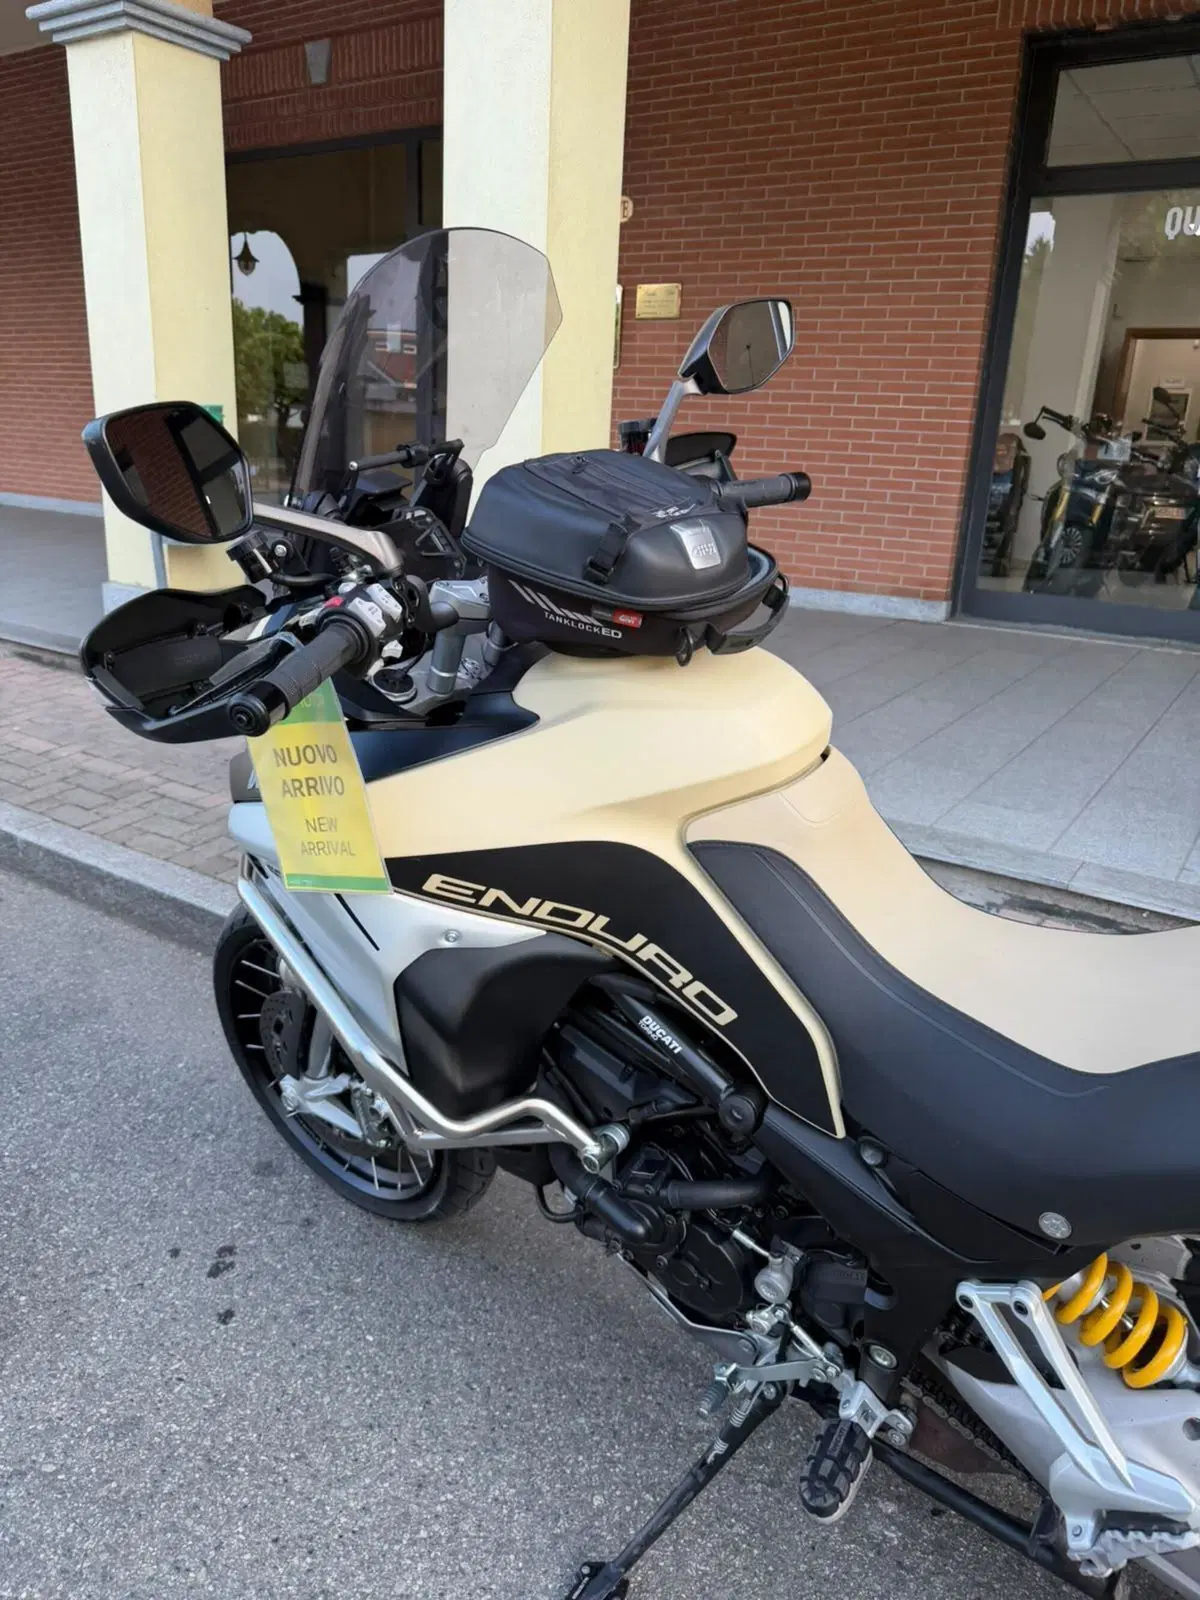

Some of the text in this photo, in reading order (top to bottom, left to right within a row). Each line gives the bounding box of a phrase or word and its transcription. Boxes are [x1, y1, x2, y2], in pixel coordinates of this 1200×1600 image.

[544, 611, 622, 639] TANKLOCKED
[273, 743, 338, 768] NUOVO
[281, 775, 345, 799] ARRIVO
[304, 816, 338, 833] NEW
[300, 840, 356, 857] ARRIVAL
[422, 873, 738, 1026] ENDURO
[642, 1015, 682, 1054] DUCATI
